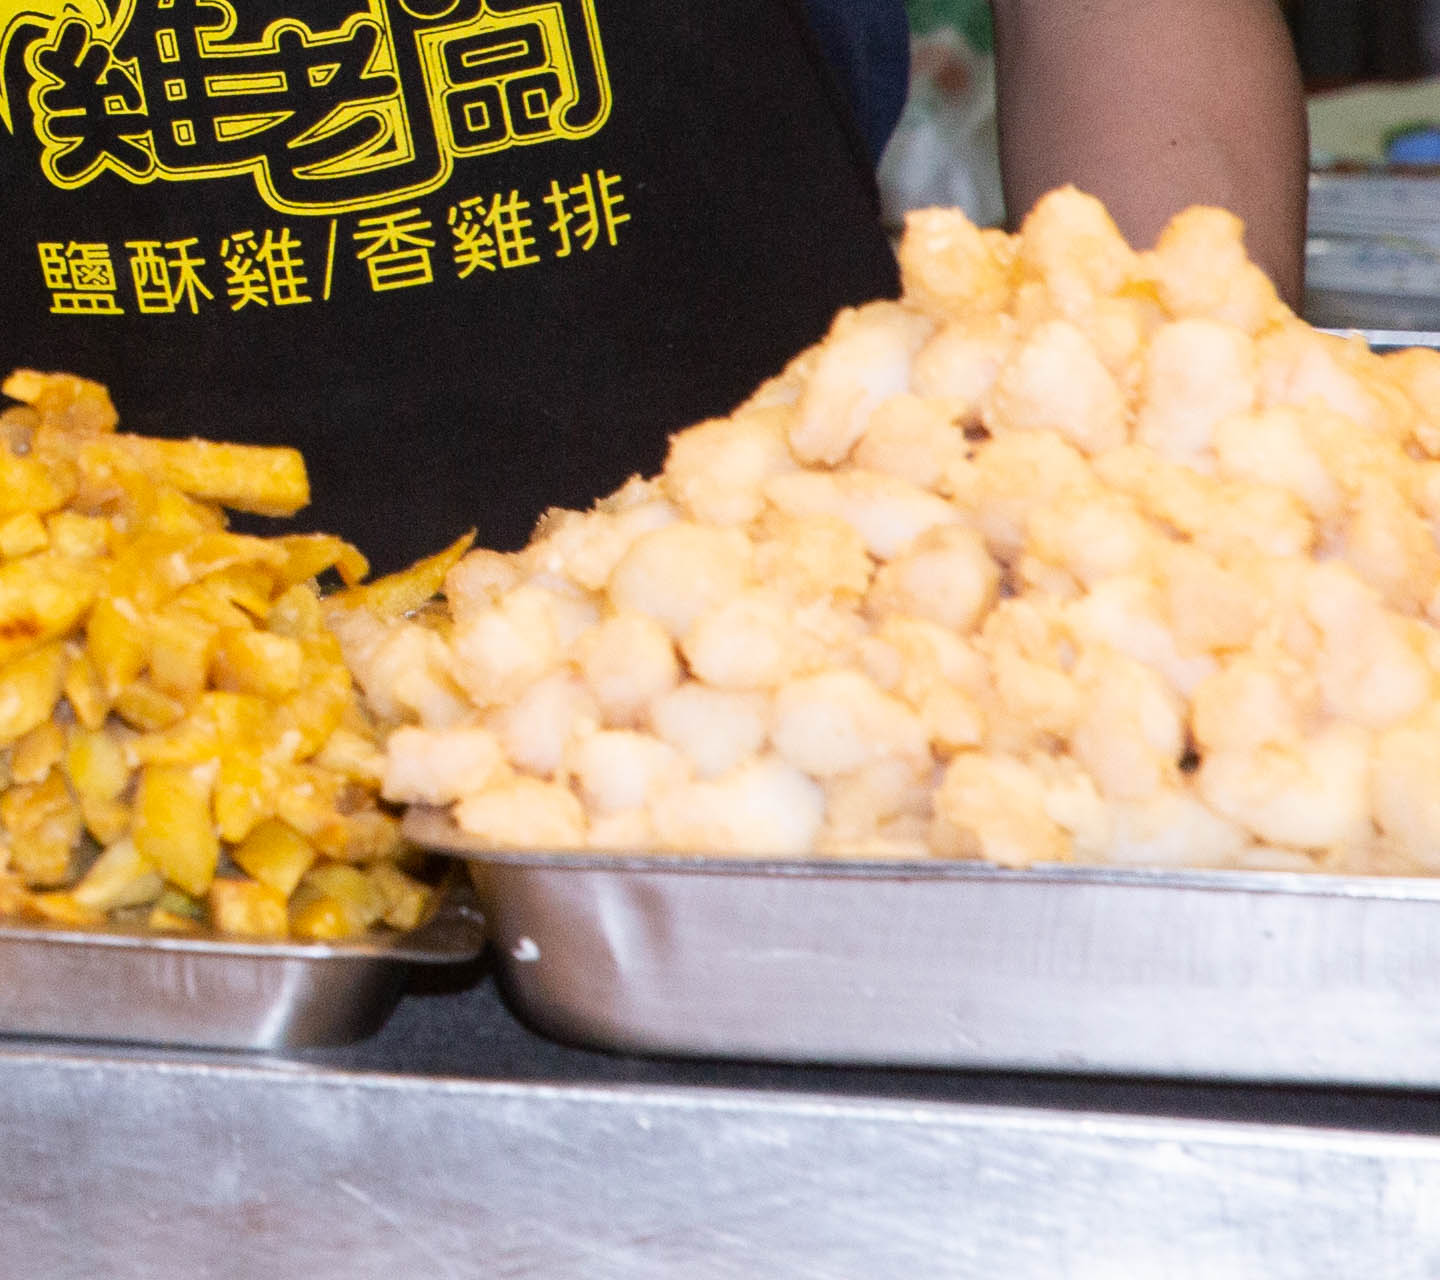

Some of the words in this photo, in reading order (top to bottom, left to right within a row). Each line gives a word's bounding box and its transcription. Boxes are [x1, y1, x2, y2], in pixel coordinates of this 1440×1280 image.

[36, 169, 632, 315] 鹽酥雞/香雞排
